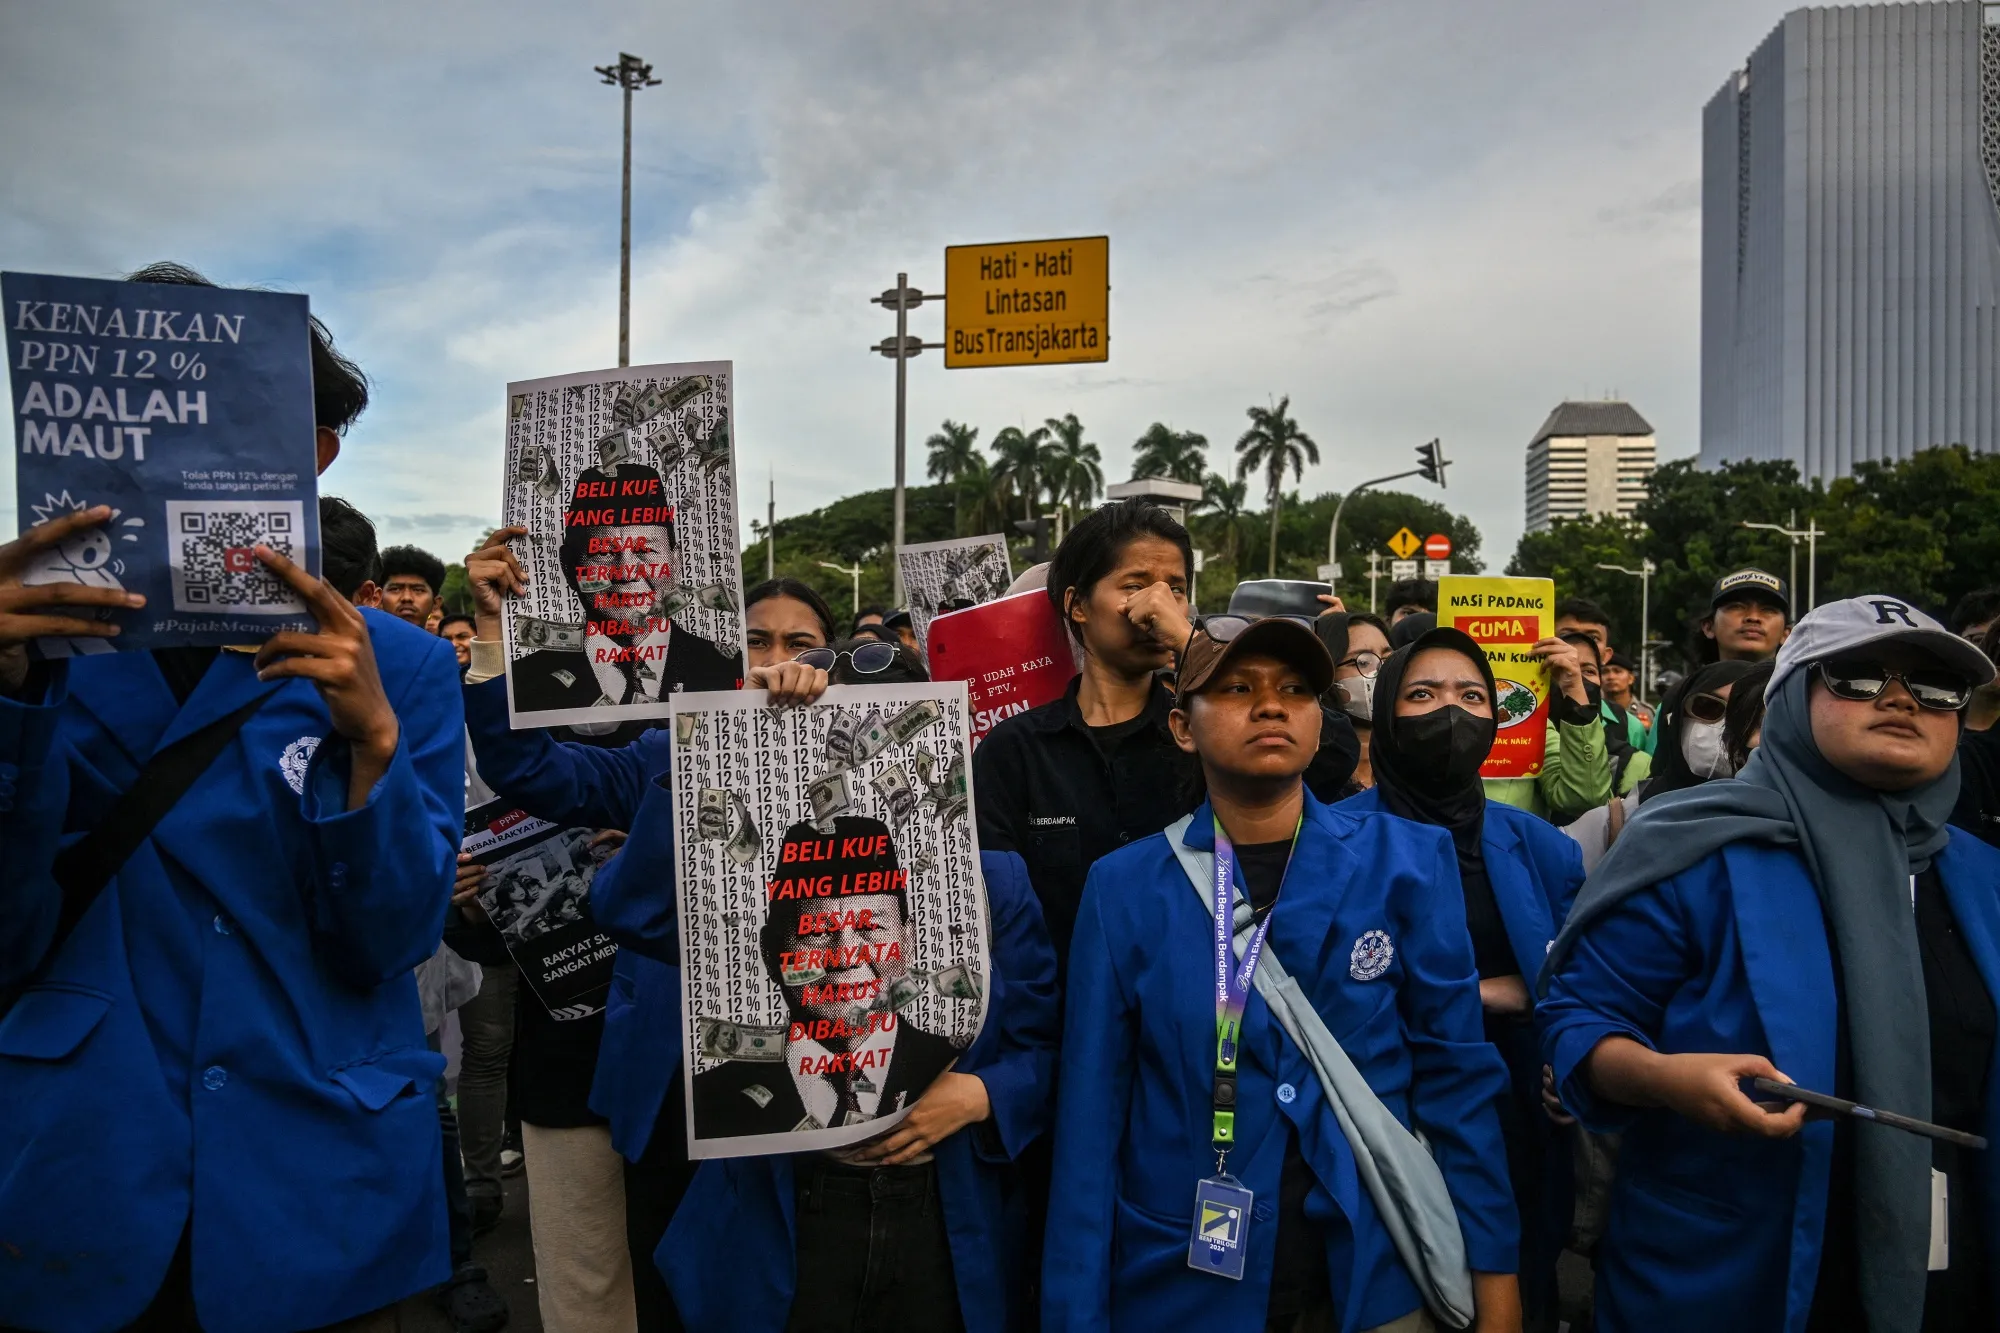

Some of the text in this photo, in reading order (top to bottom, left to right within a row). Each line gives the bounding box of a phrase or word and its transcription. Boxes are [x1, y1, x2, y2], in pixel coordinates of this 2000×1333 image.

[980, 251, 1017, 280] Hati
[1035, 248, 1072, 277] Hati
[985, 289, 1066, 315] Lintasan
[14, 300, 245, 344] KENAIKAN
[17, 340, 207, 381] PPN 12 %
[20, 381, 208, 424] ADALAH
[22, 419, 152, 461] MAUT
[181, 470, 298, 482] Tolak PPN 12% dengan
[183, 482, 213, 490] tanda
[215, 482, 251, 492] tangan
[252, 482, 280, 491] petisi
[576, 479, 659, 499] BELI KUE
[563, 506, 675, 527] YANG LEBIH
[576, 563, 671, 582] TERNYATA
[593, 590, 658, 609] HARUS
[1487, 595, 1544, 610] PADANG
[1868, 600, 1919, 628] R
[1468, 619, 1525, 638] CUMA
[595, 645, 667, 664] RAKYAT
[983, 666, 1015, 683] UDAH
[1021, 656, 1053, 672] KAYA
[969, 700, 1030, 734] ISKIN
[498, 811, 520, 827] PPN
[465, 838, 497, 854] BEBAN
[497, 822, 535, 842] RAKYAT
[782, 835, 889, 864] BELI KUE
[766, 869, 908, 901] YANG LEBIH
[798, 908, 879, 936] BESAR,
[1215, 851, 1231, 1002] Kabinet Bergerak Berdampak
[542, 938, 592, 967] RAKYAT
[779, 941, 901, 973] TERNYATA
[542, 954, 592, 983] SANGAT
[801, 978, 884, 1007] HARUS
[799, 1047, 892, 1076] RAKYAT
[1209, 1243, 1225, 1253] 2024
[1212, 1238, 1237, 1249] TRILOGI
